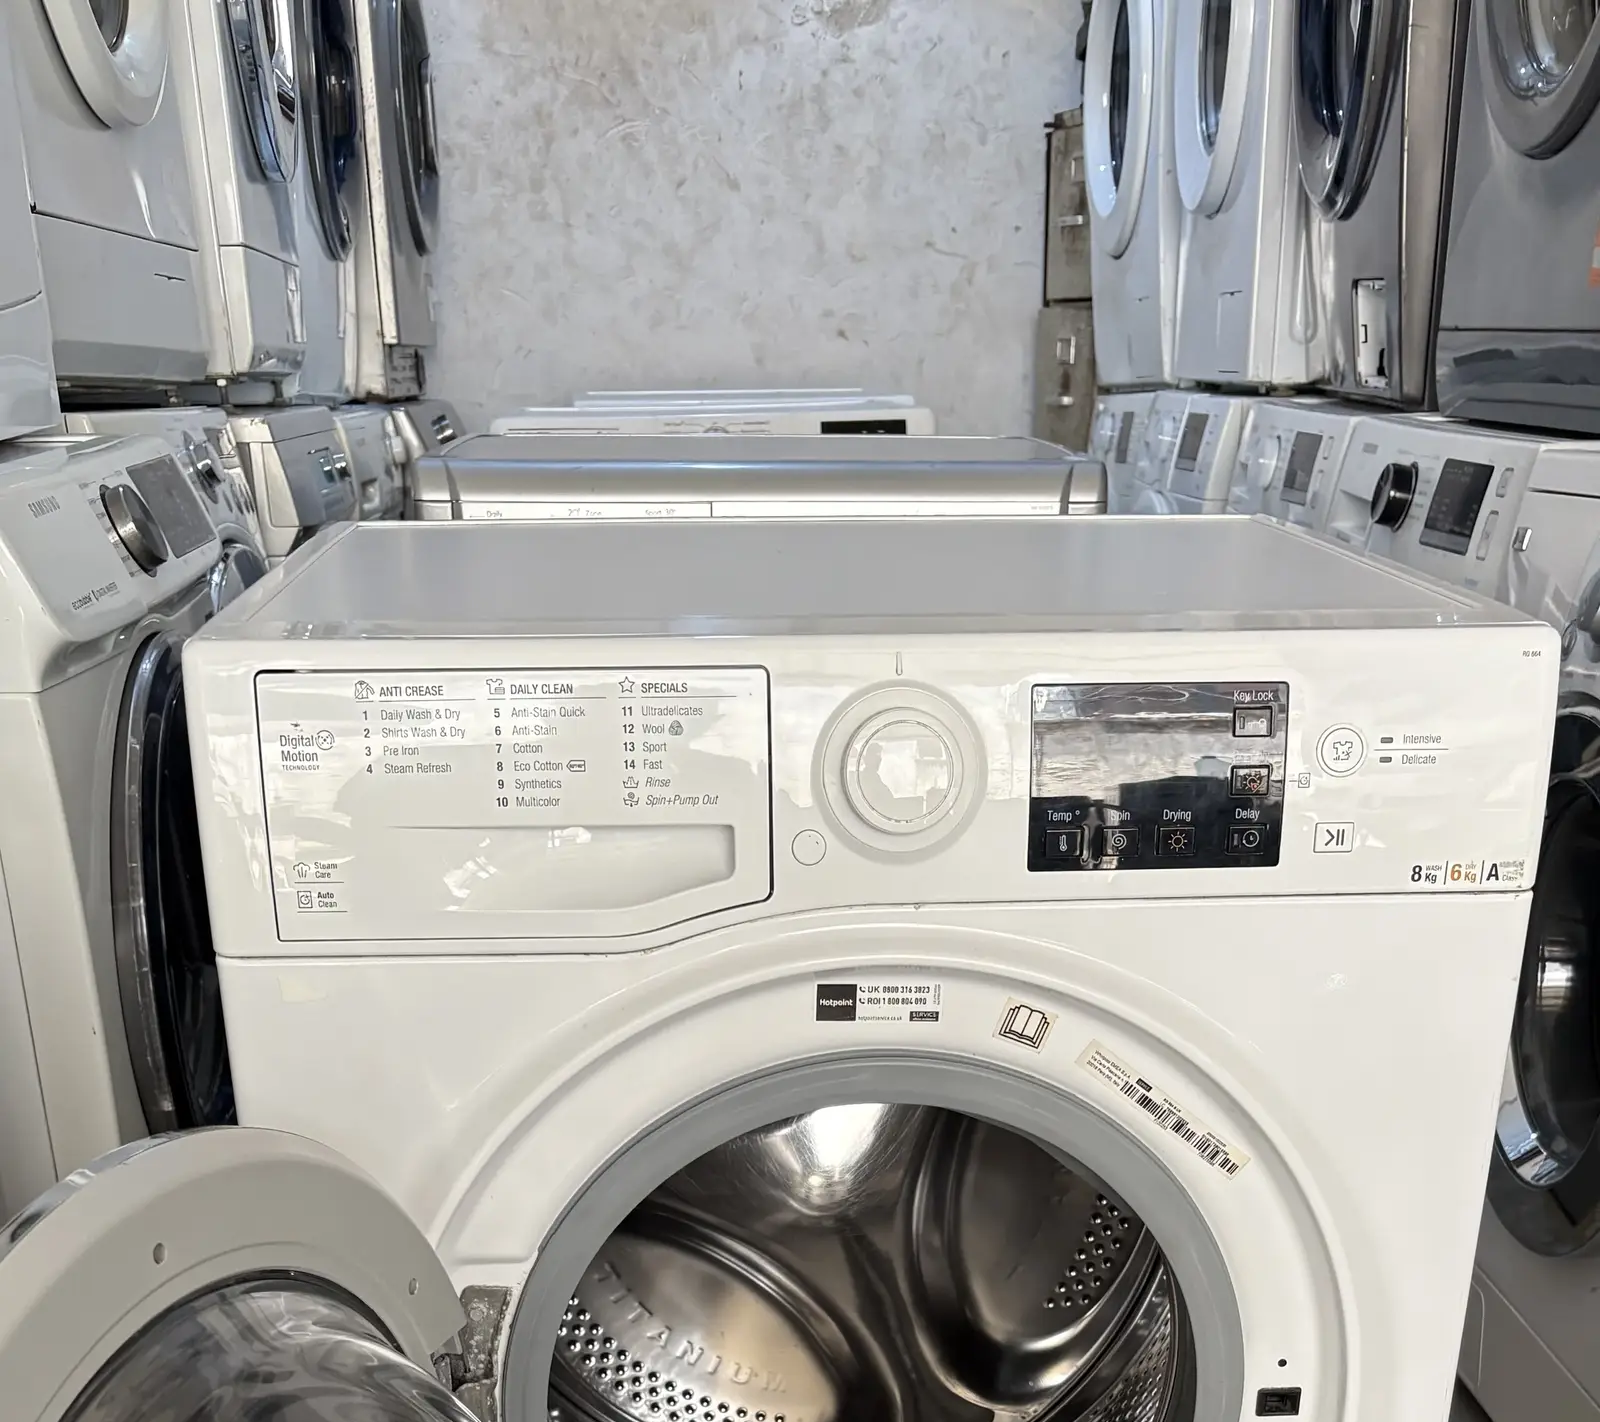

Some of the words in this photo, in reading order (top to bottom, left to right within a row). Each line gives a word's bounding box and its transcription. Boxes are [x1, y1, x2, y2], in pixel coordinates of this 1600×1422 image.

[379, 686, 402, 697] ANTI
[405, 685, 444, 697] CREASE
[510, 684, 539, 695] DAILY
[541, 683, 574, 695] CLEAN
[641, 682, 688, 694] SPECIALS
[1234, 691, 1251, 702] Key
[1253, 691, 1274, 701] Lock
[362, 710, 368, 720] 1
[380, 709, 403, 722] Daily
[406, 709, 432, 720] Wash
[435, 709, 442, 719] &
[445, 708, 461, 721] Dry
[493, 708, 501, 718] 5
[511, 707, 557, 718] Anti-Stain
[559, 706, 586, 718] Quick
[621, 706, 633, 716] 11
[641, 705, 704, 716] Ultradelicates
[363, 728, 371, 738] 2
[381, 727, 409, 738] Shirts
[411, 727, 437, 737] Wash
[440, 727, 447, 737] &
[449, 726, 466, 739] Dry
[494, 726, 502, 736] 6
[512, 725, 558, 735] Anti-Stain
[622, 724, 635, 734] 12
[642, 724, 666, 734] Wool
[279, 734, 315, 750] Digital
[1403, 734, 1442, 744] Intensive
[364, 746, 372, 757] 3
[383, 746, 399, 756] Pre
[401, 745, 420, 756] Iron
[495, 743, 502, 754] 7
[512, 743, 543, 754] Cotton
[623, 742, 635, 752] 13
[642, 741, 667, 754] Sport
[281, 750, 319, 762] Motion
[1401, 754, 1437, 765] Delicate
[366, 764, 373, 774] 4
[384, 763, 414, 774] Steam
[416, 762, 452, 774] Refresh
[496, 761, 504, 772] 8
[513, 761, 531, 772] Eco
[533, 760, 564, 771] Cotton
[623, 759, 636, 770] 14
[643, 759, 663, 770] Fast
[497, 779, 505, 790] 9
[514, 778, 562, 792] Synthetics
[645, 777, 671, 788] Rinse
[496, 797, 509, 808] 10
[515, 796, 561, 808] Multicolor
[645, 795, 700, 807] Spin+Pump
[702, 794, 719, 805] Out
[1047, 810, 1073, 822] Temp
[1110, 810, 1131, 822] Spin
[1163, 808, 1192, 822] Drying
[1235, 808, 1261, 820] Delay
[314, 862, 338, 870] Steam
[1486, 863, 1500, 881] A
[315, 871, 331, 879] Care
[1410, 865, 1423, 883] 8
[1424, 872, 1437, 884] Kg
[1450, 863, 1462, 882] 6
[1464, 871, 1477, 883] Kg
[318, 900, 338, 908] Clean
[819, 999, 853, 1007] Hotpoint
